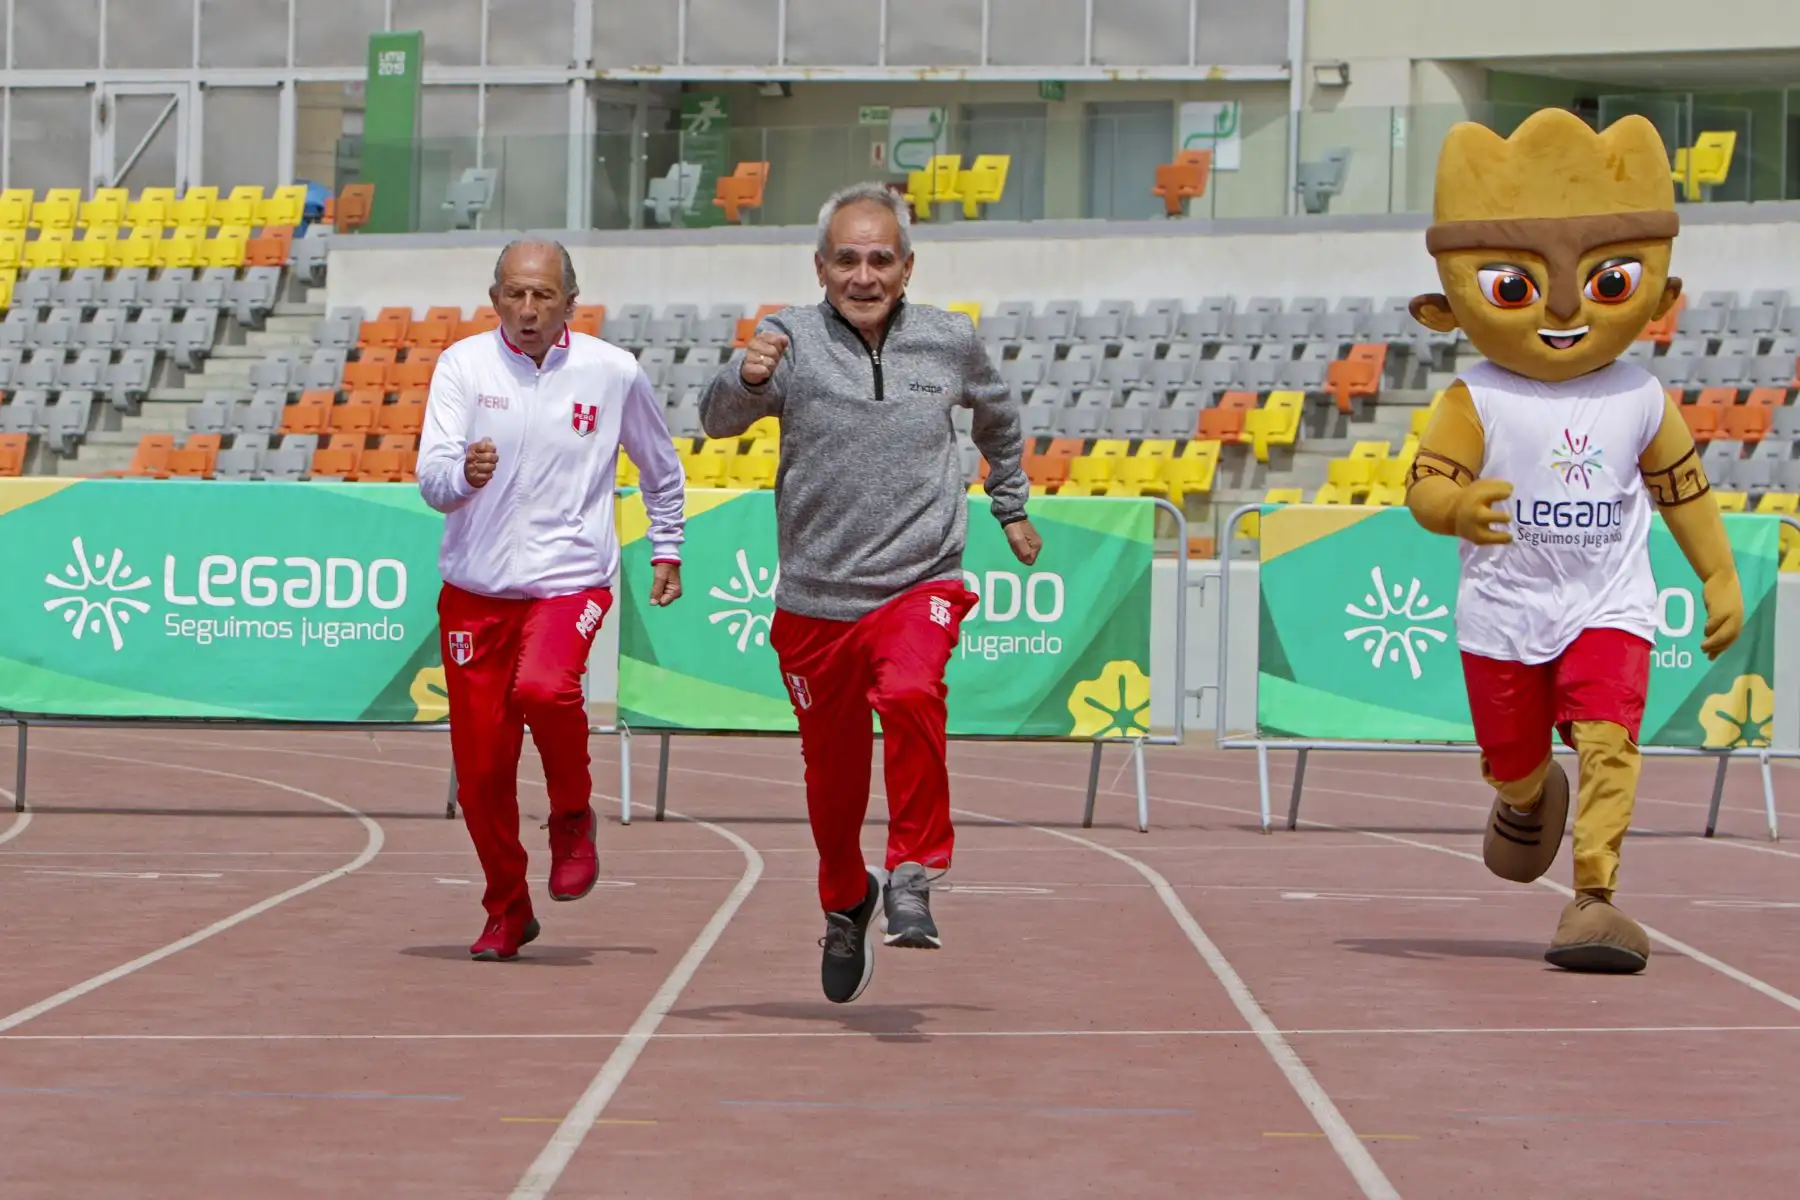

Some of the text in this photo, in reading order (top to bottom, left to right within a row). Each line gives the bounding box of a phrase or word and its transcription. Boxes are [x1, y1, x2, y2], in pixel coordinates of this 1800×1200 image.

[1517, 527, 1580, 546] Seguimos
[165, 613, 405, 648] Seguimos jugando
[961, 629, 1063, 661] jugando
